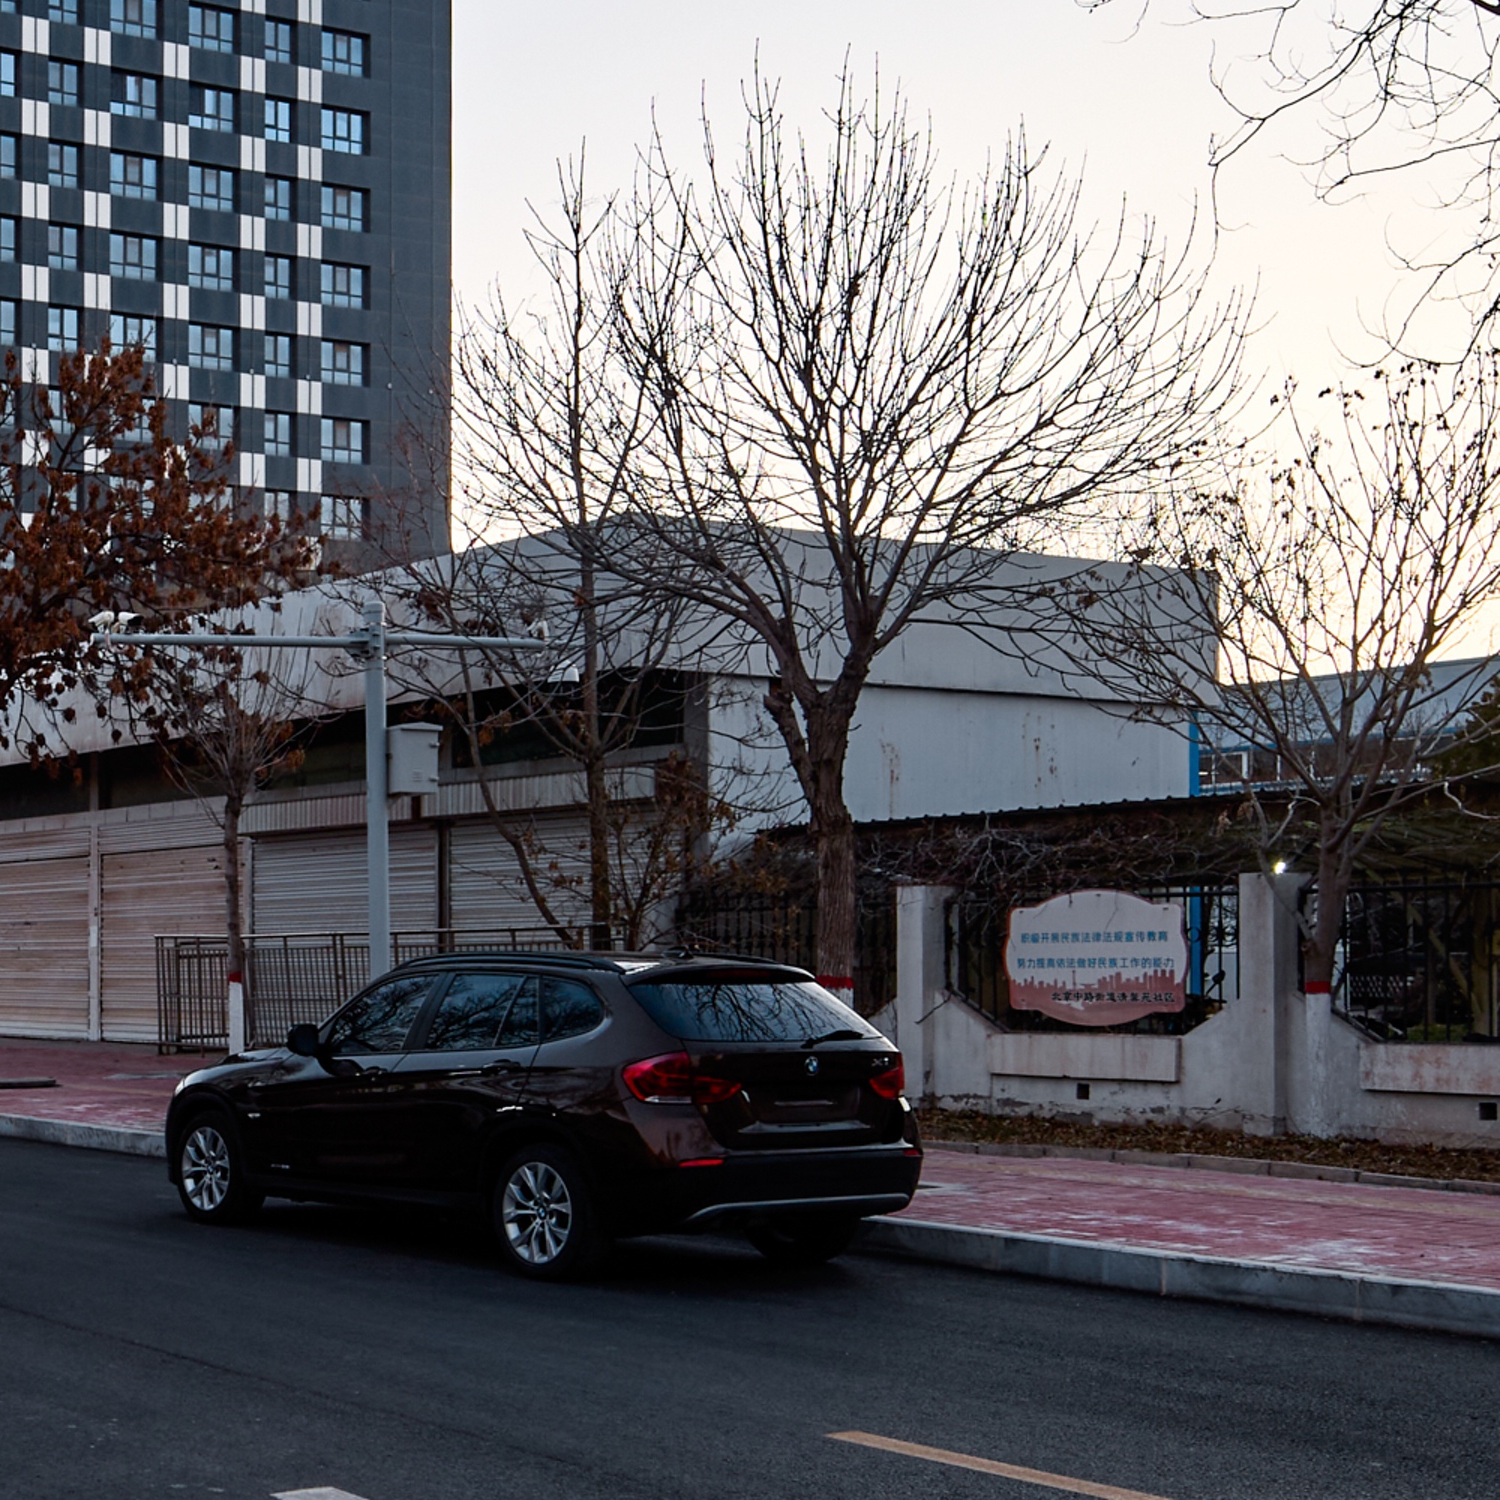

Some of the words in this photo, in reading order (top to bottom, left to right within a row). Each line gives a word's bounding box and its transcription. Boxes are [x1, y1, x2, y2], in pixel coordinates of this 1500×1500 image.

[1020, 931, 1168, 944] 积极开展民族法律法规宣传教育
[1017, 956, 1175, 969] 努力提高依法做好民族工作的能力
